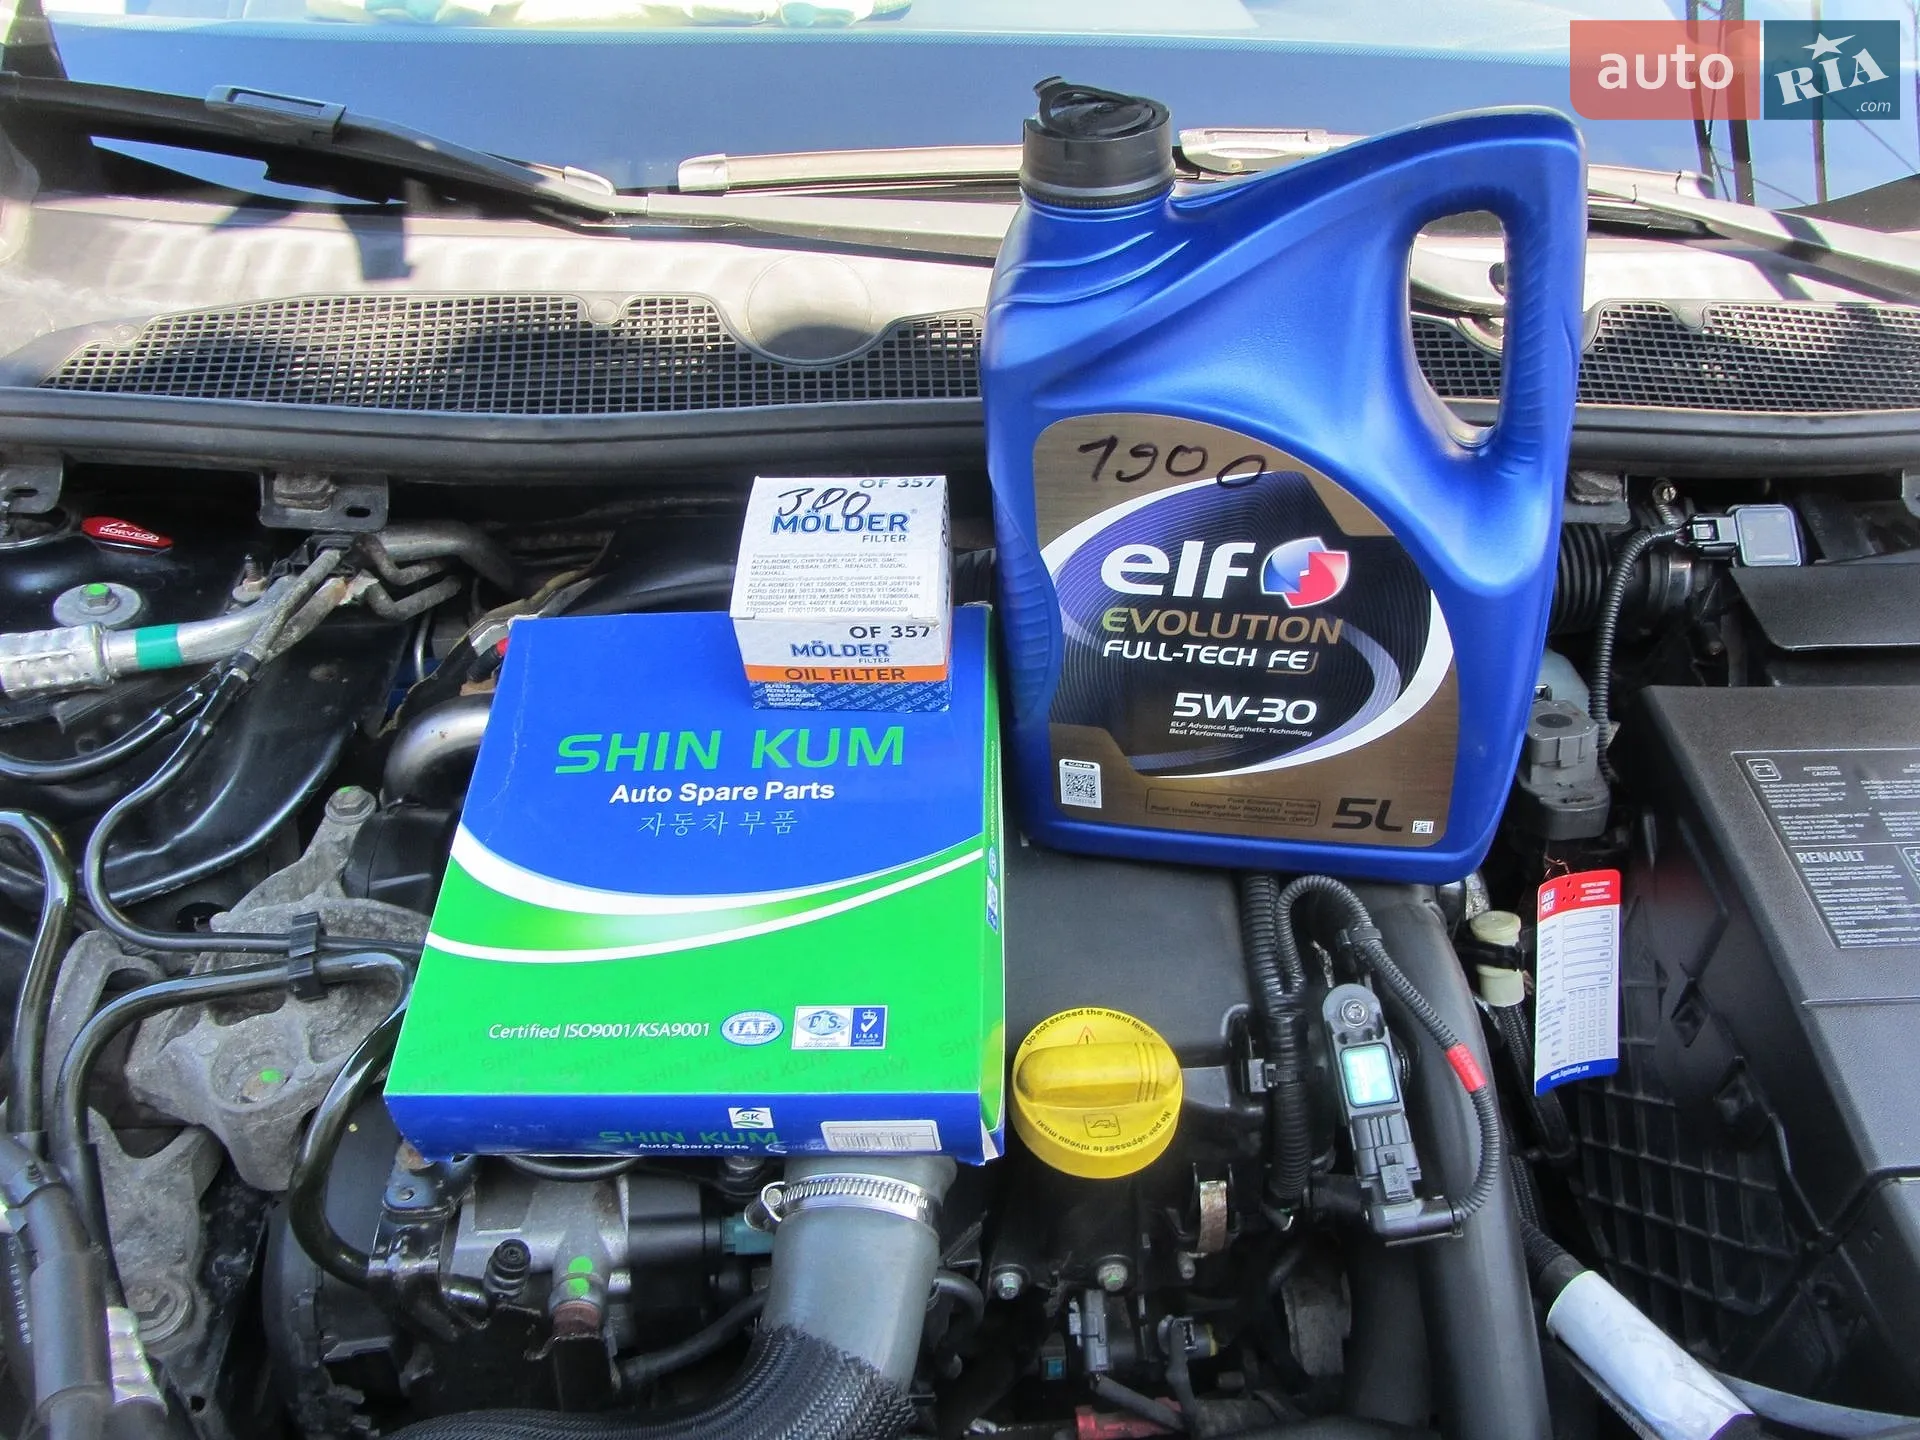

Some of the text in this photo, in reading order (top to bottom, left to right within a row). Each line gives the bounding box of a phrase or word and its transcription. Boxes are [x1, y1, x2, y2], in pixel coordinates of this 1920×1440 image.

[1078, 435, 1266, 488] 1900
[859, 478, 938, 488] OF 357
[771, 509, 910, 534] MÖLDER
[862, 535, 907, 543] FILTER
[1100, 541, 1256, 599] elf
[849, 626, 931, 638] OF 357
[1102, 608, 1343, 644] EVOLUTION
[791, 640, 890, 657] MÖLDER
[1102, 640, 1310, 670] FULL-TECH FE
[785, 668, 905, 680] OIL FILTER
[1173, 693, 1318, 724] 5W-30
[1187, 722, 1226, 731] Advanced
[1228, 725, 1266, 734] Synthetic
[1269, 727, 1313, 737] Technology
[1189, 729, 1244, 739] Performances
[555, 726, 905, 774] SHIN KUM
[609, 781, 835, 806] Auto Spare Parts
[1331, 797, 1402, 832] 5L
[637, 810, 798, 838] 자동차 부품
[1795, 850, 1864, 863] RENAULT
[489, 1022, 710, 1039] Certified ISO9001/KSA9001
[733, 1020, 772, 1035] IAF
[1025, 1034, 1036, 1047] Do
[1035, 1023, 1050, 1037] not
[1049, 1009, 1084, 1025] exceed
[1086, 1009, 1103, 1017] the
[1106, 1011, 1131, 1024] maxi
[741, 1113, 760, 1121] SK
[600, 1131, 779, 1144] SHIN KUM
[638, 1142, 669, 1150] Auto
[672, 1143, 711, 1151] Spare
